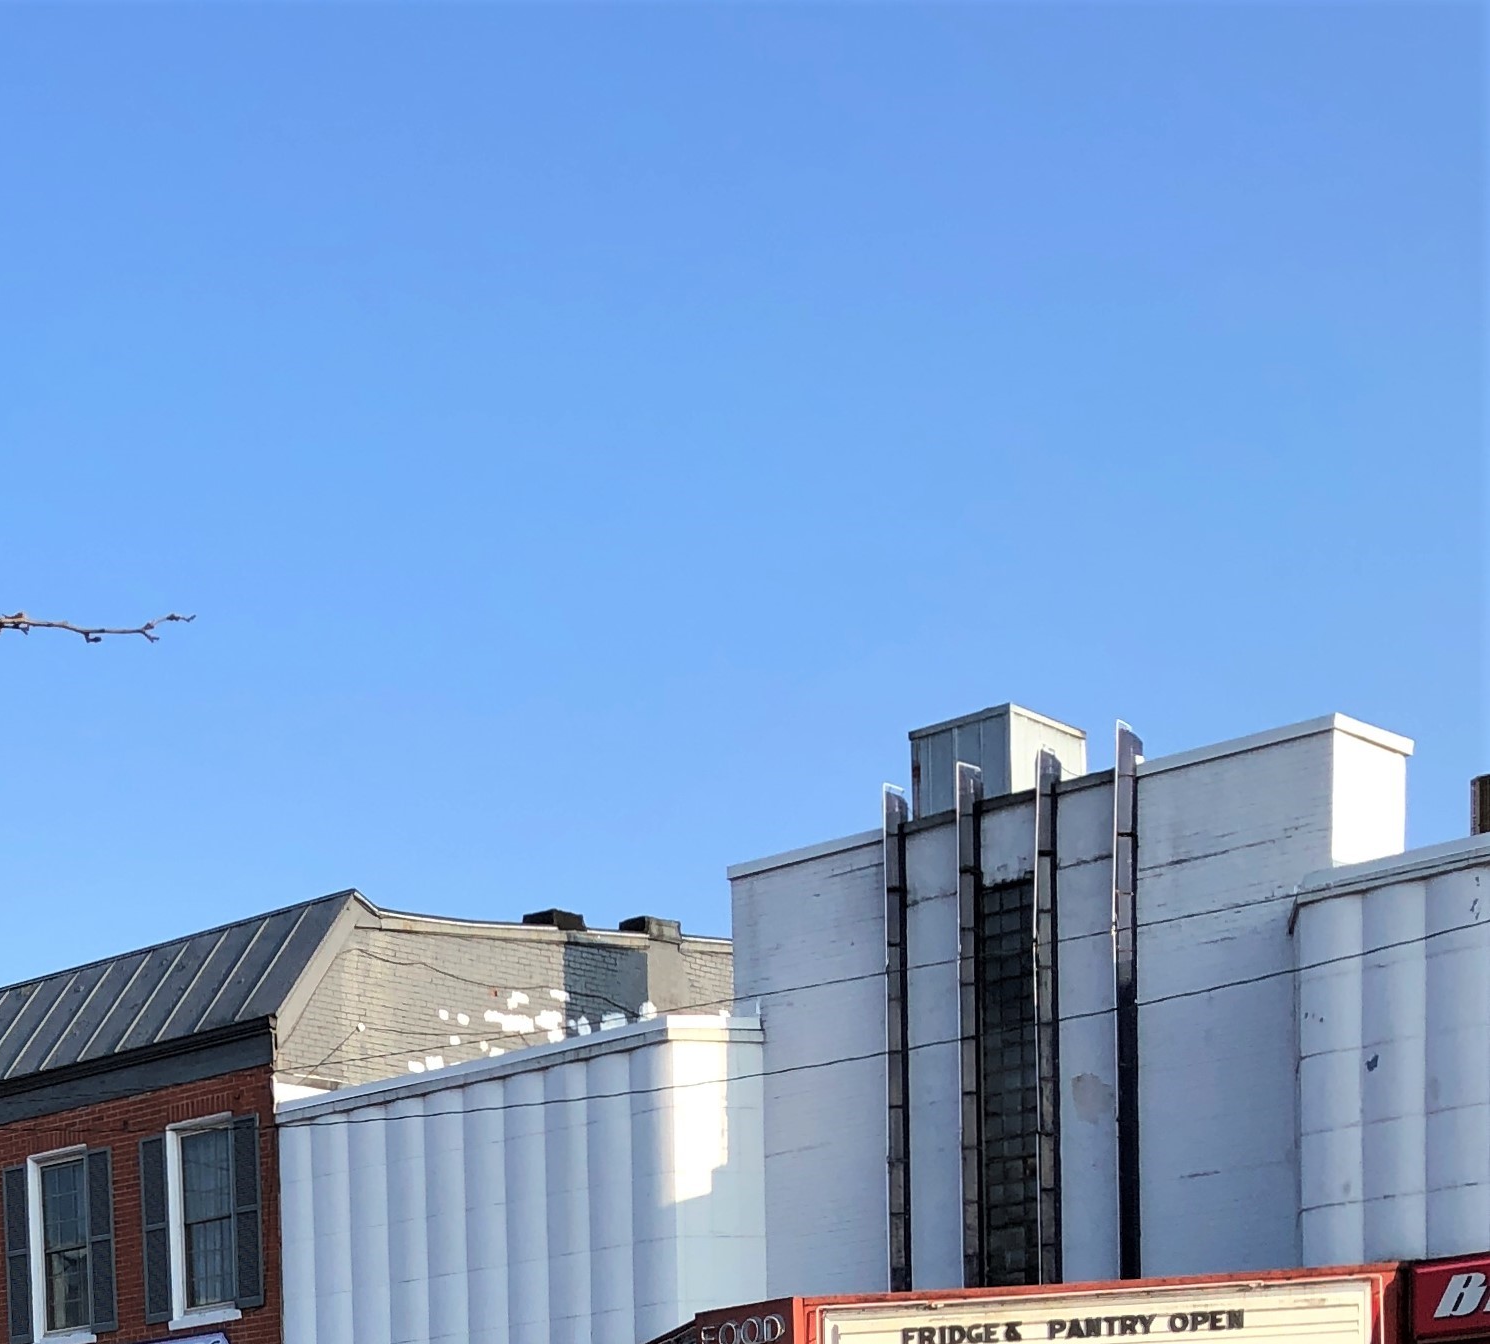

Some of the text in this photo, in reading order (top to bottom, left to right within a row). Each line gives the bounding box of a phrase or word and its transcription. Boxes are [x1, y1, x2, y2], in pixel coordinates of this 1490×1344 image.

[1433, 1271, 1490, 1319] B
[1046, 1314, 1157, 1340] PANTRY
[1167, 1309, 1245, 1332] OPEN
